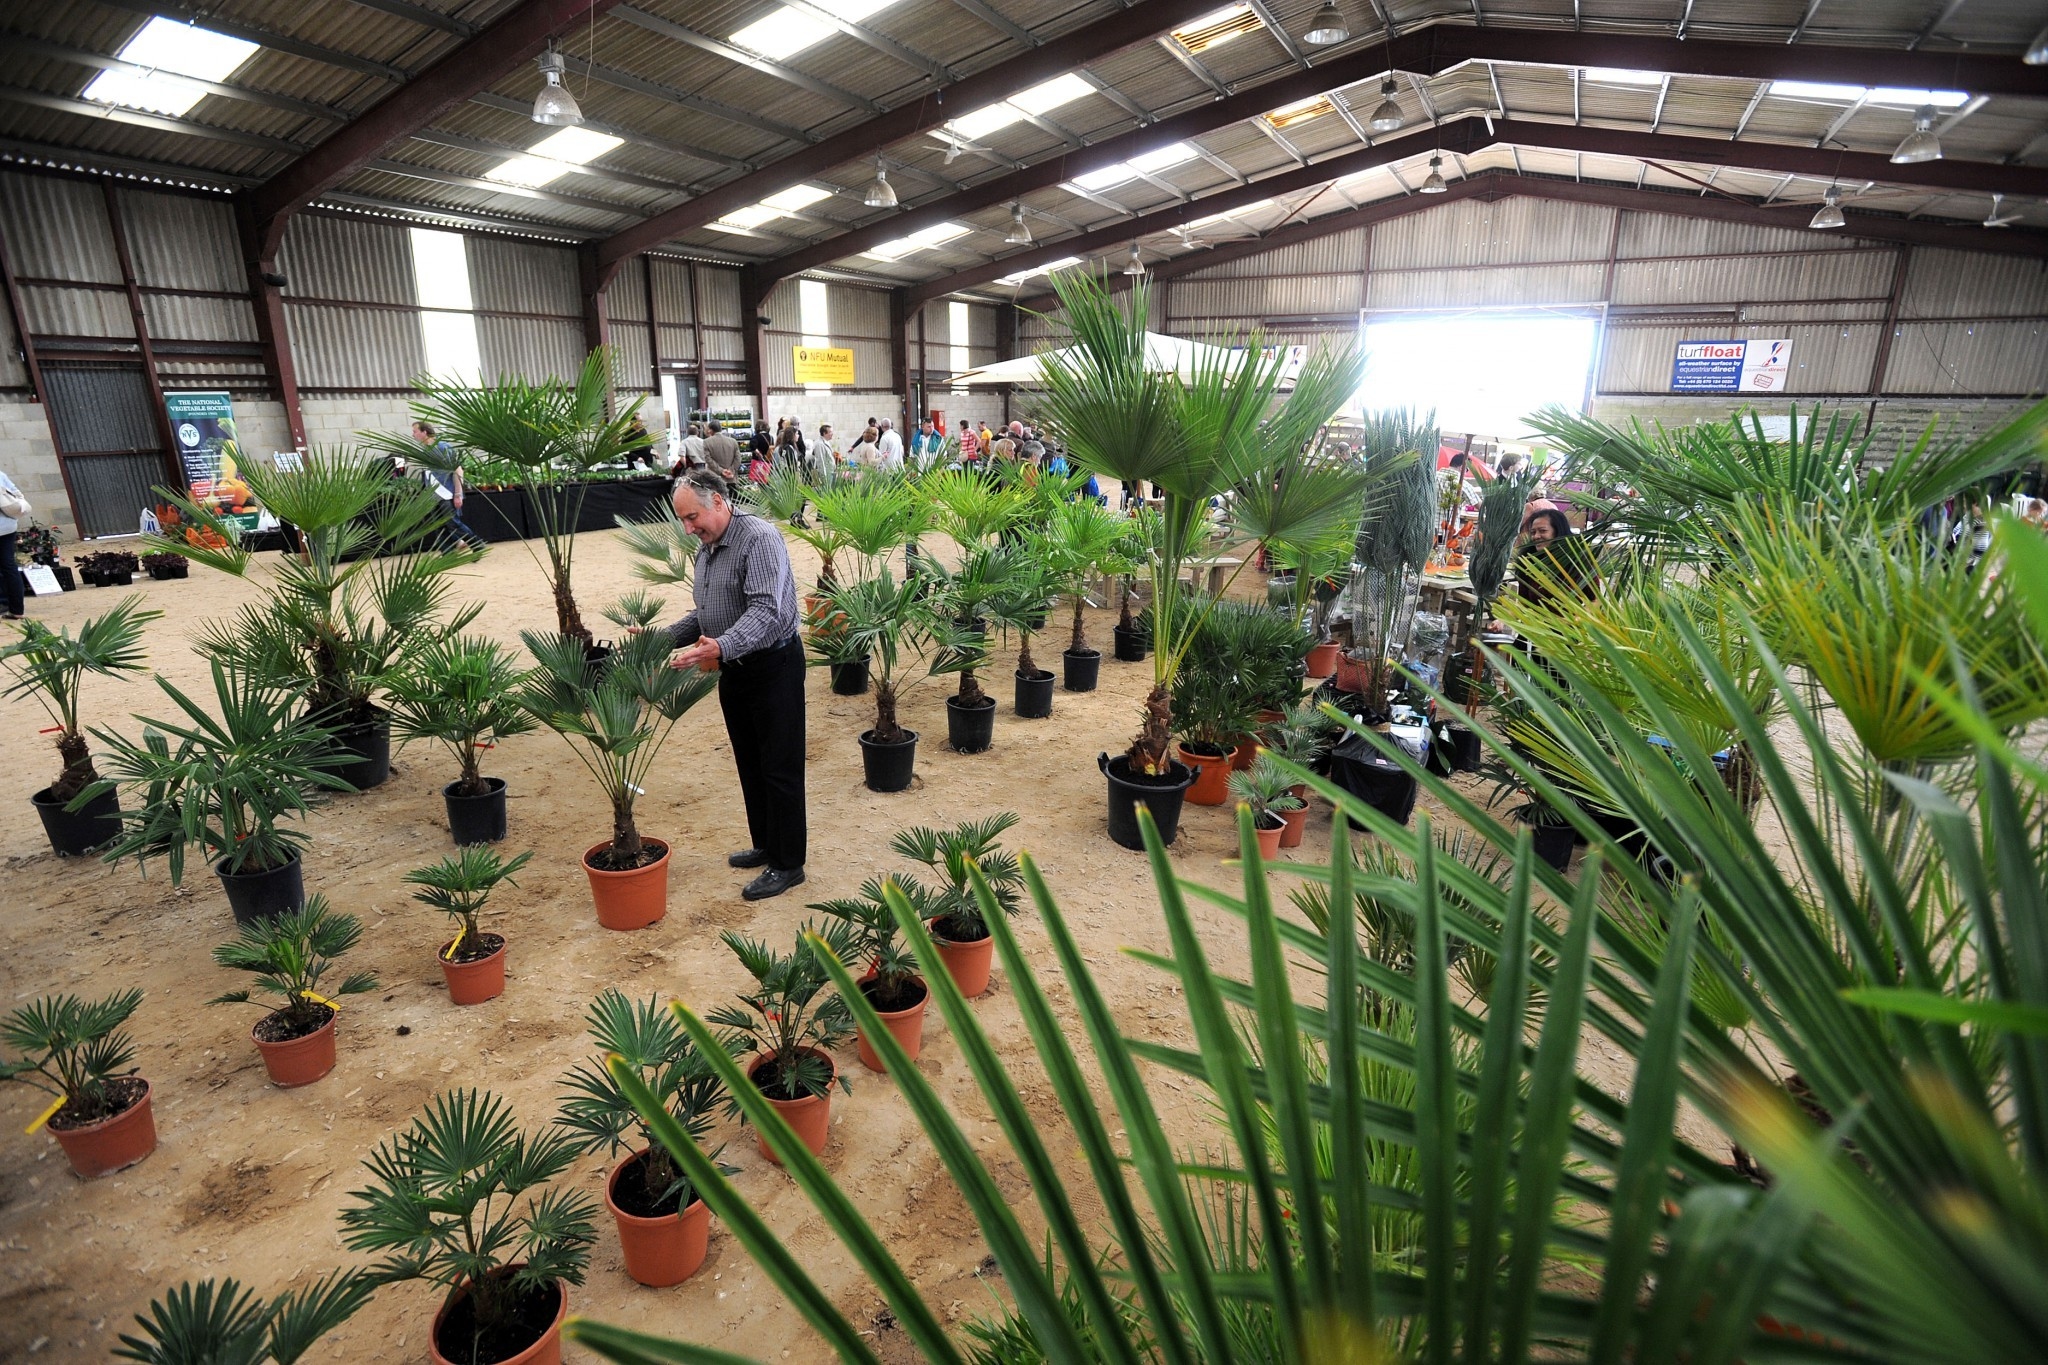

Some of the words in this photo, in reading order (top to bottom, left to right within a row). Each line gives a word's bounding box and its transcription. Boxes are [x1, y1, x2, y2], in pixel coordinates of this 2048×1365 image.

[810, 351, 826, 362] NFU
[826, 353, 849, 363] Mutual
[1680, 345, 1742, 358] turffloat
[1679, 364, 1736, 374] equestriandirect
